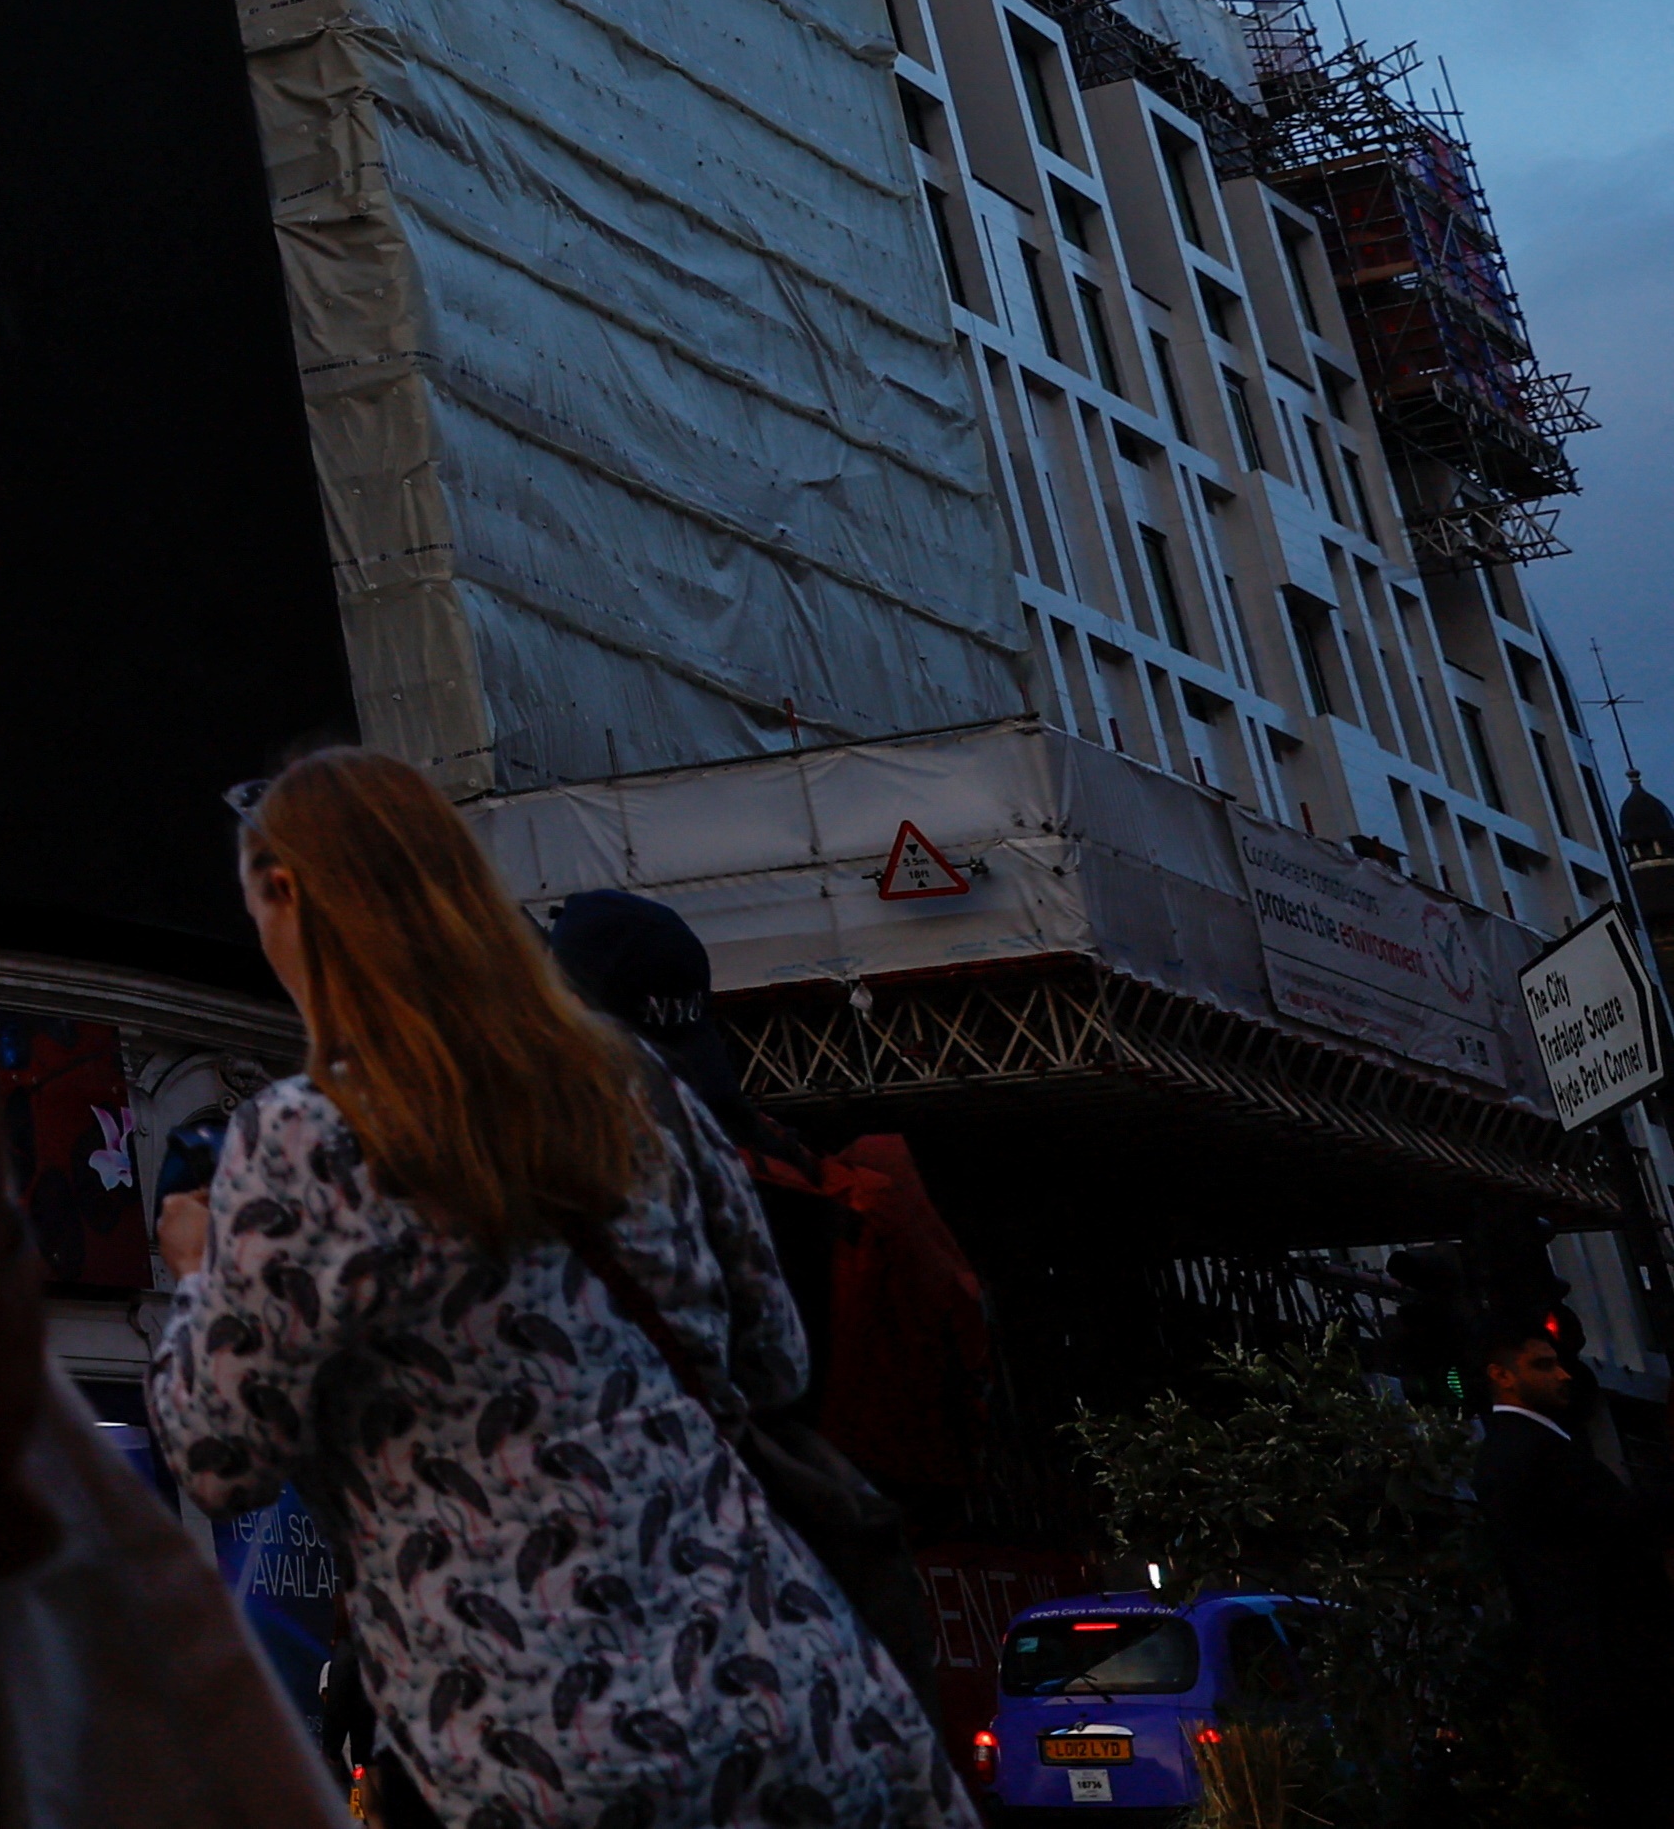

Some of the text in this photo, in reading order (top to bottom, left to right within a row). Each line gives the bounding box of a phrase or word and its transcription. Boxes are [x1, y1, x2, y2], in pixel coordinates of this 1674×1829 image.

[1256, 889, 1312, 933] protect
[1526, 972, 1571, 1020] The City
[1540, 995, 1625, 1066] Trafalgar Square
[1553, 1042, 1643, 1118] Hyde Park Corner
[251, 1552, 342, 1600] AVAILA
[1090, 1742, 1121, 1757] LYD
